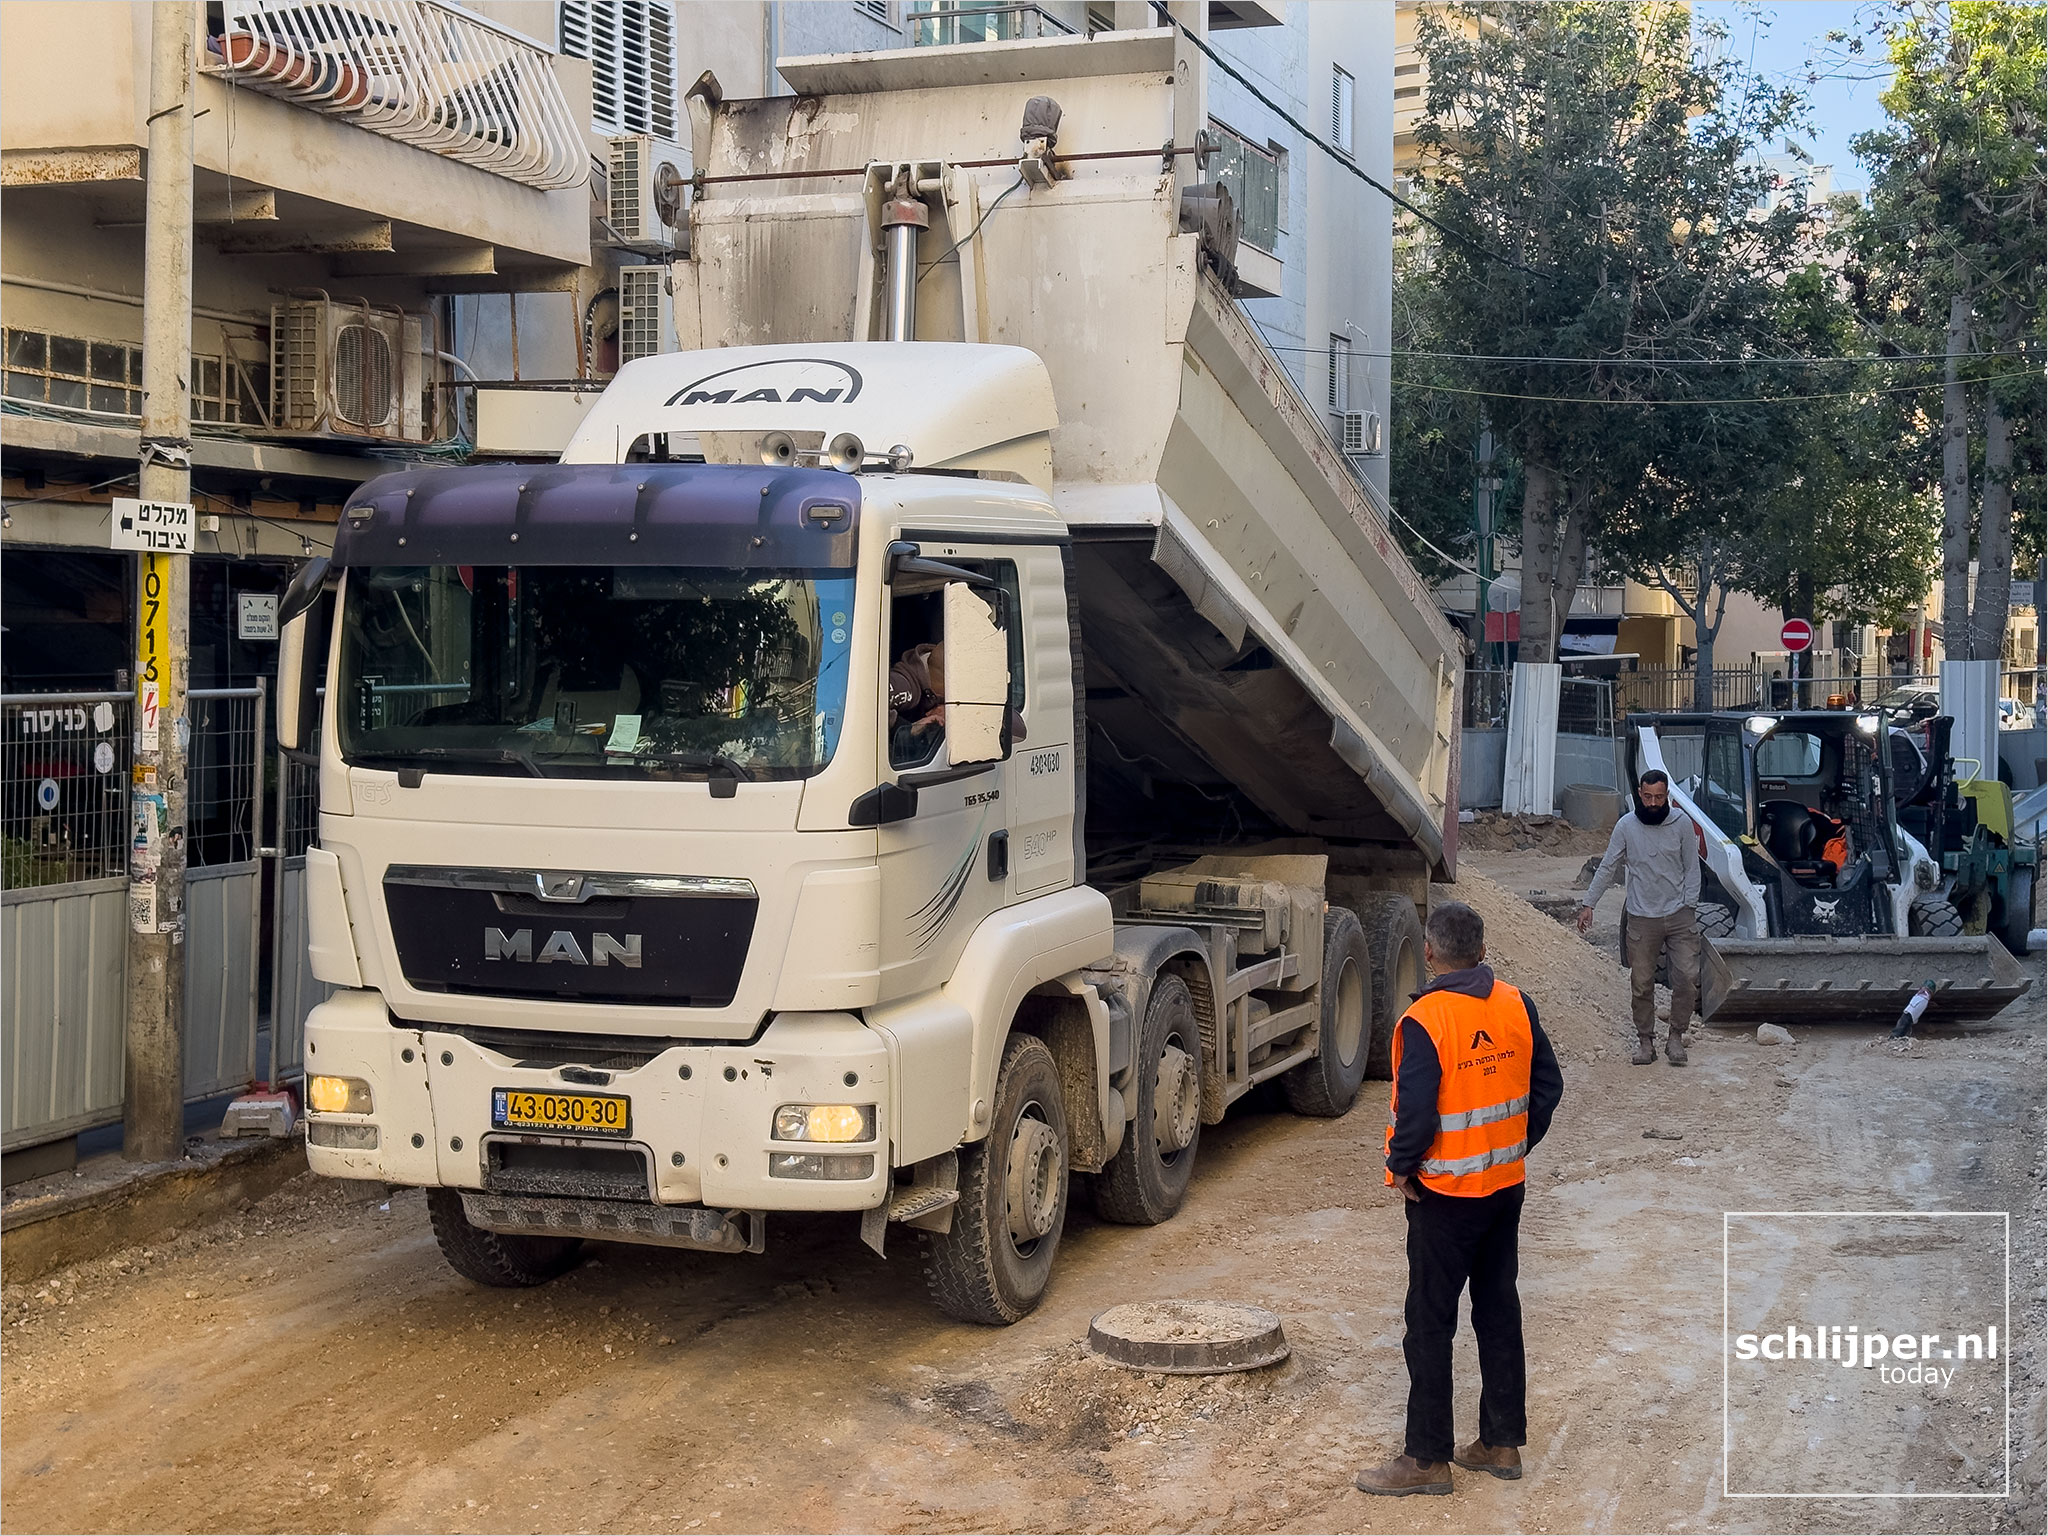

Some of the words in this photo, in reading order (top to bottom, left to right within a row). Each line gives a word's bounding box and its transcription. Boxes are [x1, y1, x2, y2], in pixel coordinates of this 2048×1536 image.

[680, 388, 845, 406] MAN
[138, 503, 187, 526] מקלט
[136, 529, 187, 550] ציבורי
[22, 708, 87, 734] כניסה
[484, 927, 643, 968] MAN
